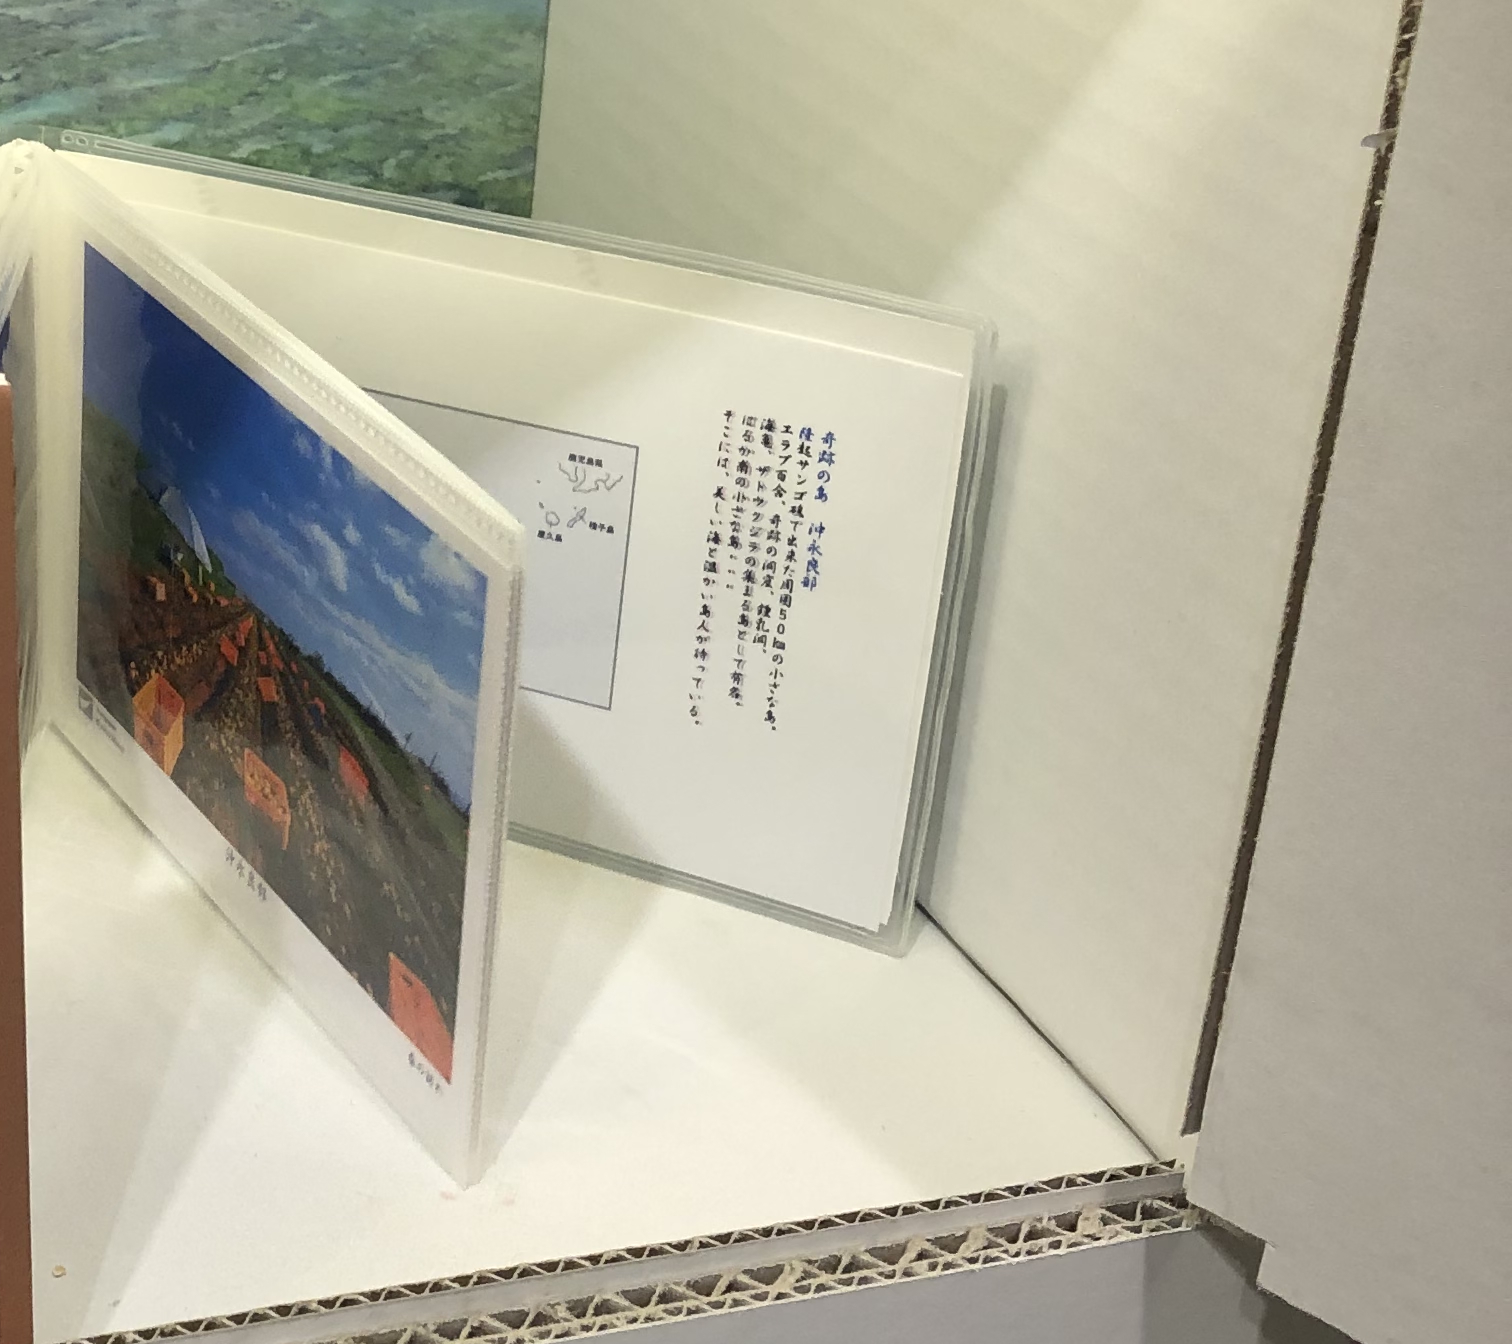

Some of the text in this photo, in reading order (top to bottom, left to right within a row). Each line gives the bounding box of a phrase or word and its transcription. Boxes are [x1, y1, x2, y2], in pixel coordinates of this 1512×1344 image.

[801, 431, 836, 592] 奇跡の島 沖永良部
